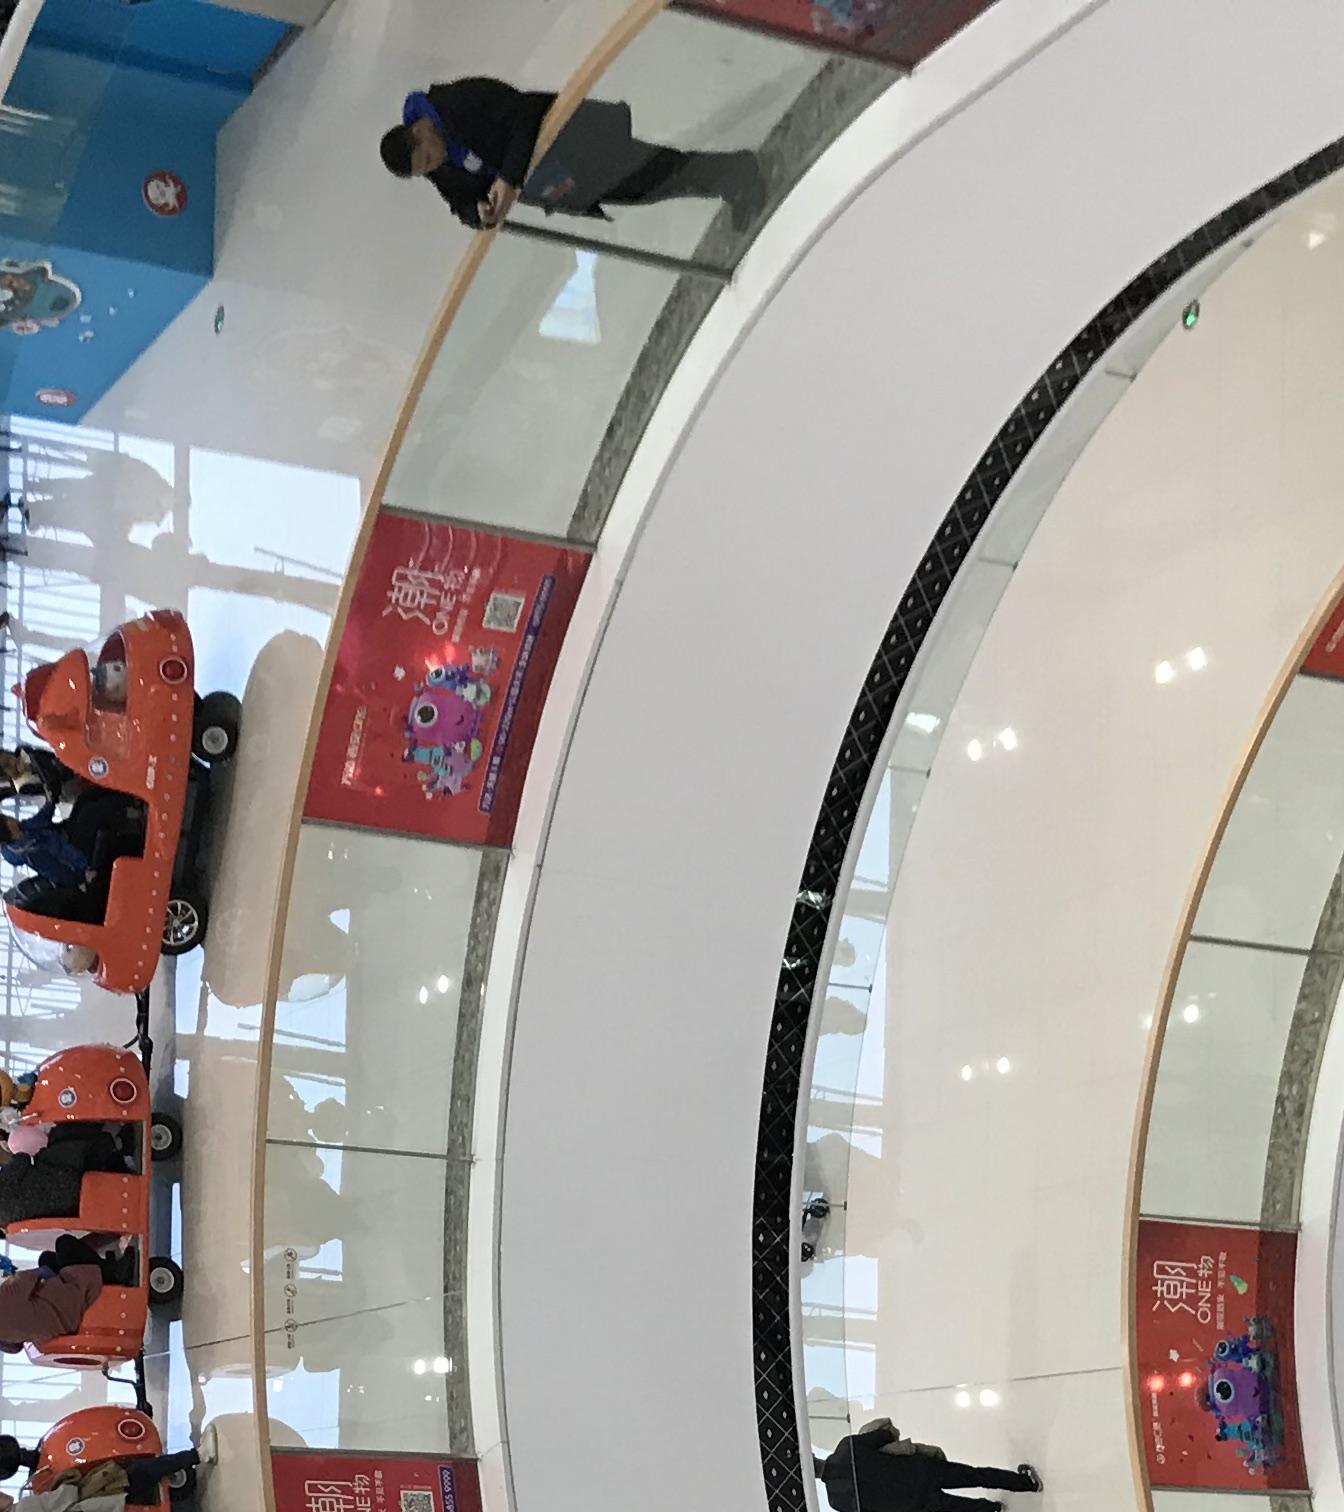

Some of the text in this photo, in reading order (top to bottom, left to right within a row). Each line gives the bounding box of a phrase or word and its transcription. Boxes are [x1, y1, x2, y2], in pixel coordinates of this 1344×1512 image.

[382, 563, 443, 623] 潮
[1152, 1259, 1196, 1313] 潮
[1197, 1254, 1215, 1323] ONE物
